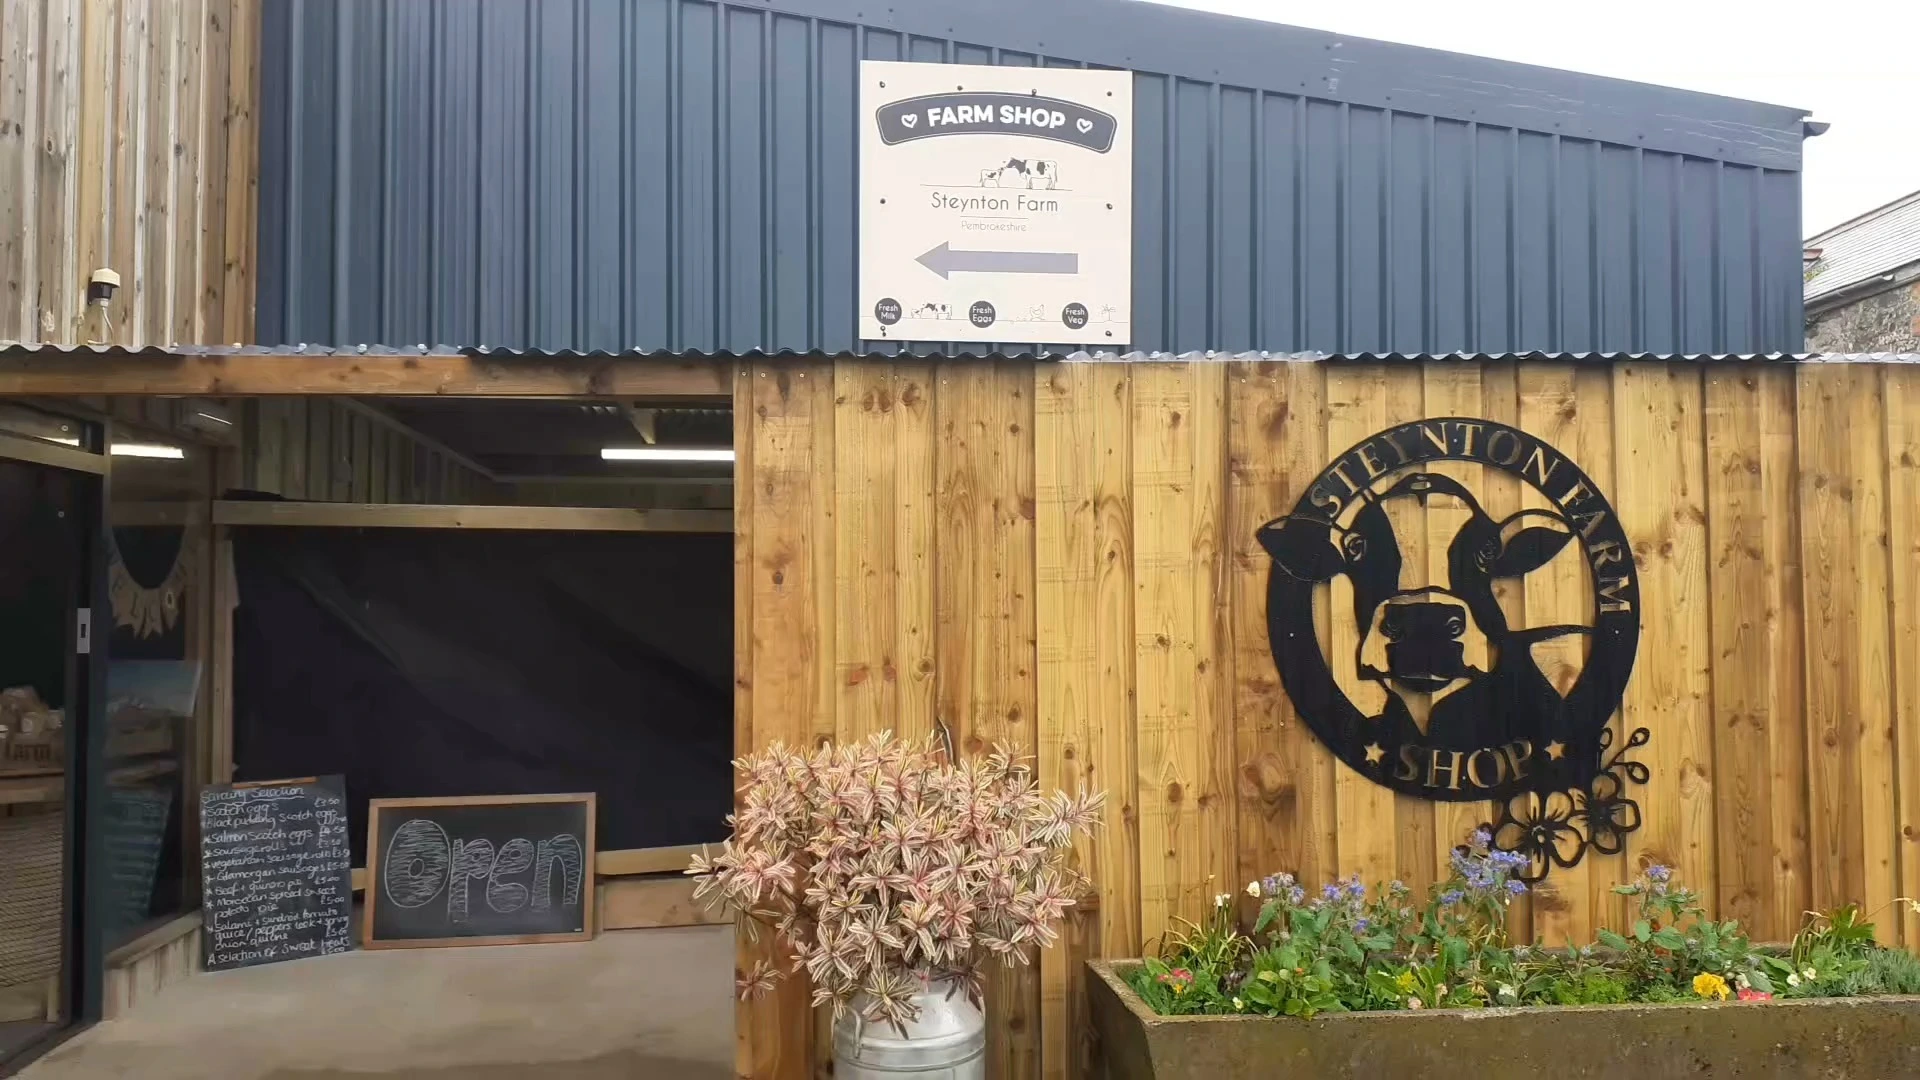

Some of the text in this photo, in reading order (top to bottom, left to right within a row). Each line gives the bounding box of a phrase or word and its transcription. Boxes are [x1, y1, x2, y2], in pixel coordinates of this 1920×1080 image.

[927, 104, 1066, 129] FARM SHOP
[931, 191, 1058, 212] Steynton Farm
[961, 220, 1027, 232] Pembrokeshire
[878, 303, 899, 312] Fresh
[972, 305, 993, 315] Fresh
[1065, 307, 1085, 316] Fresh
[880, 311, 896, 320] Milk
[972, 314, 993, 323] Eggs
[1067, 315, 1084, 325] Veg
[1311, 422, 1631, 613] STEYNTON FARM
[1393, 738, 1534, 790] SHOP
[210, 830, 248, 843] Salmon
[288, 829, 313, 846] eggs
[384, 819, 583, 918] Open
[207, 953, 216, 965] A
